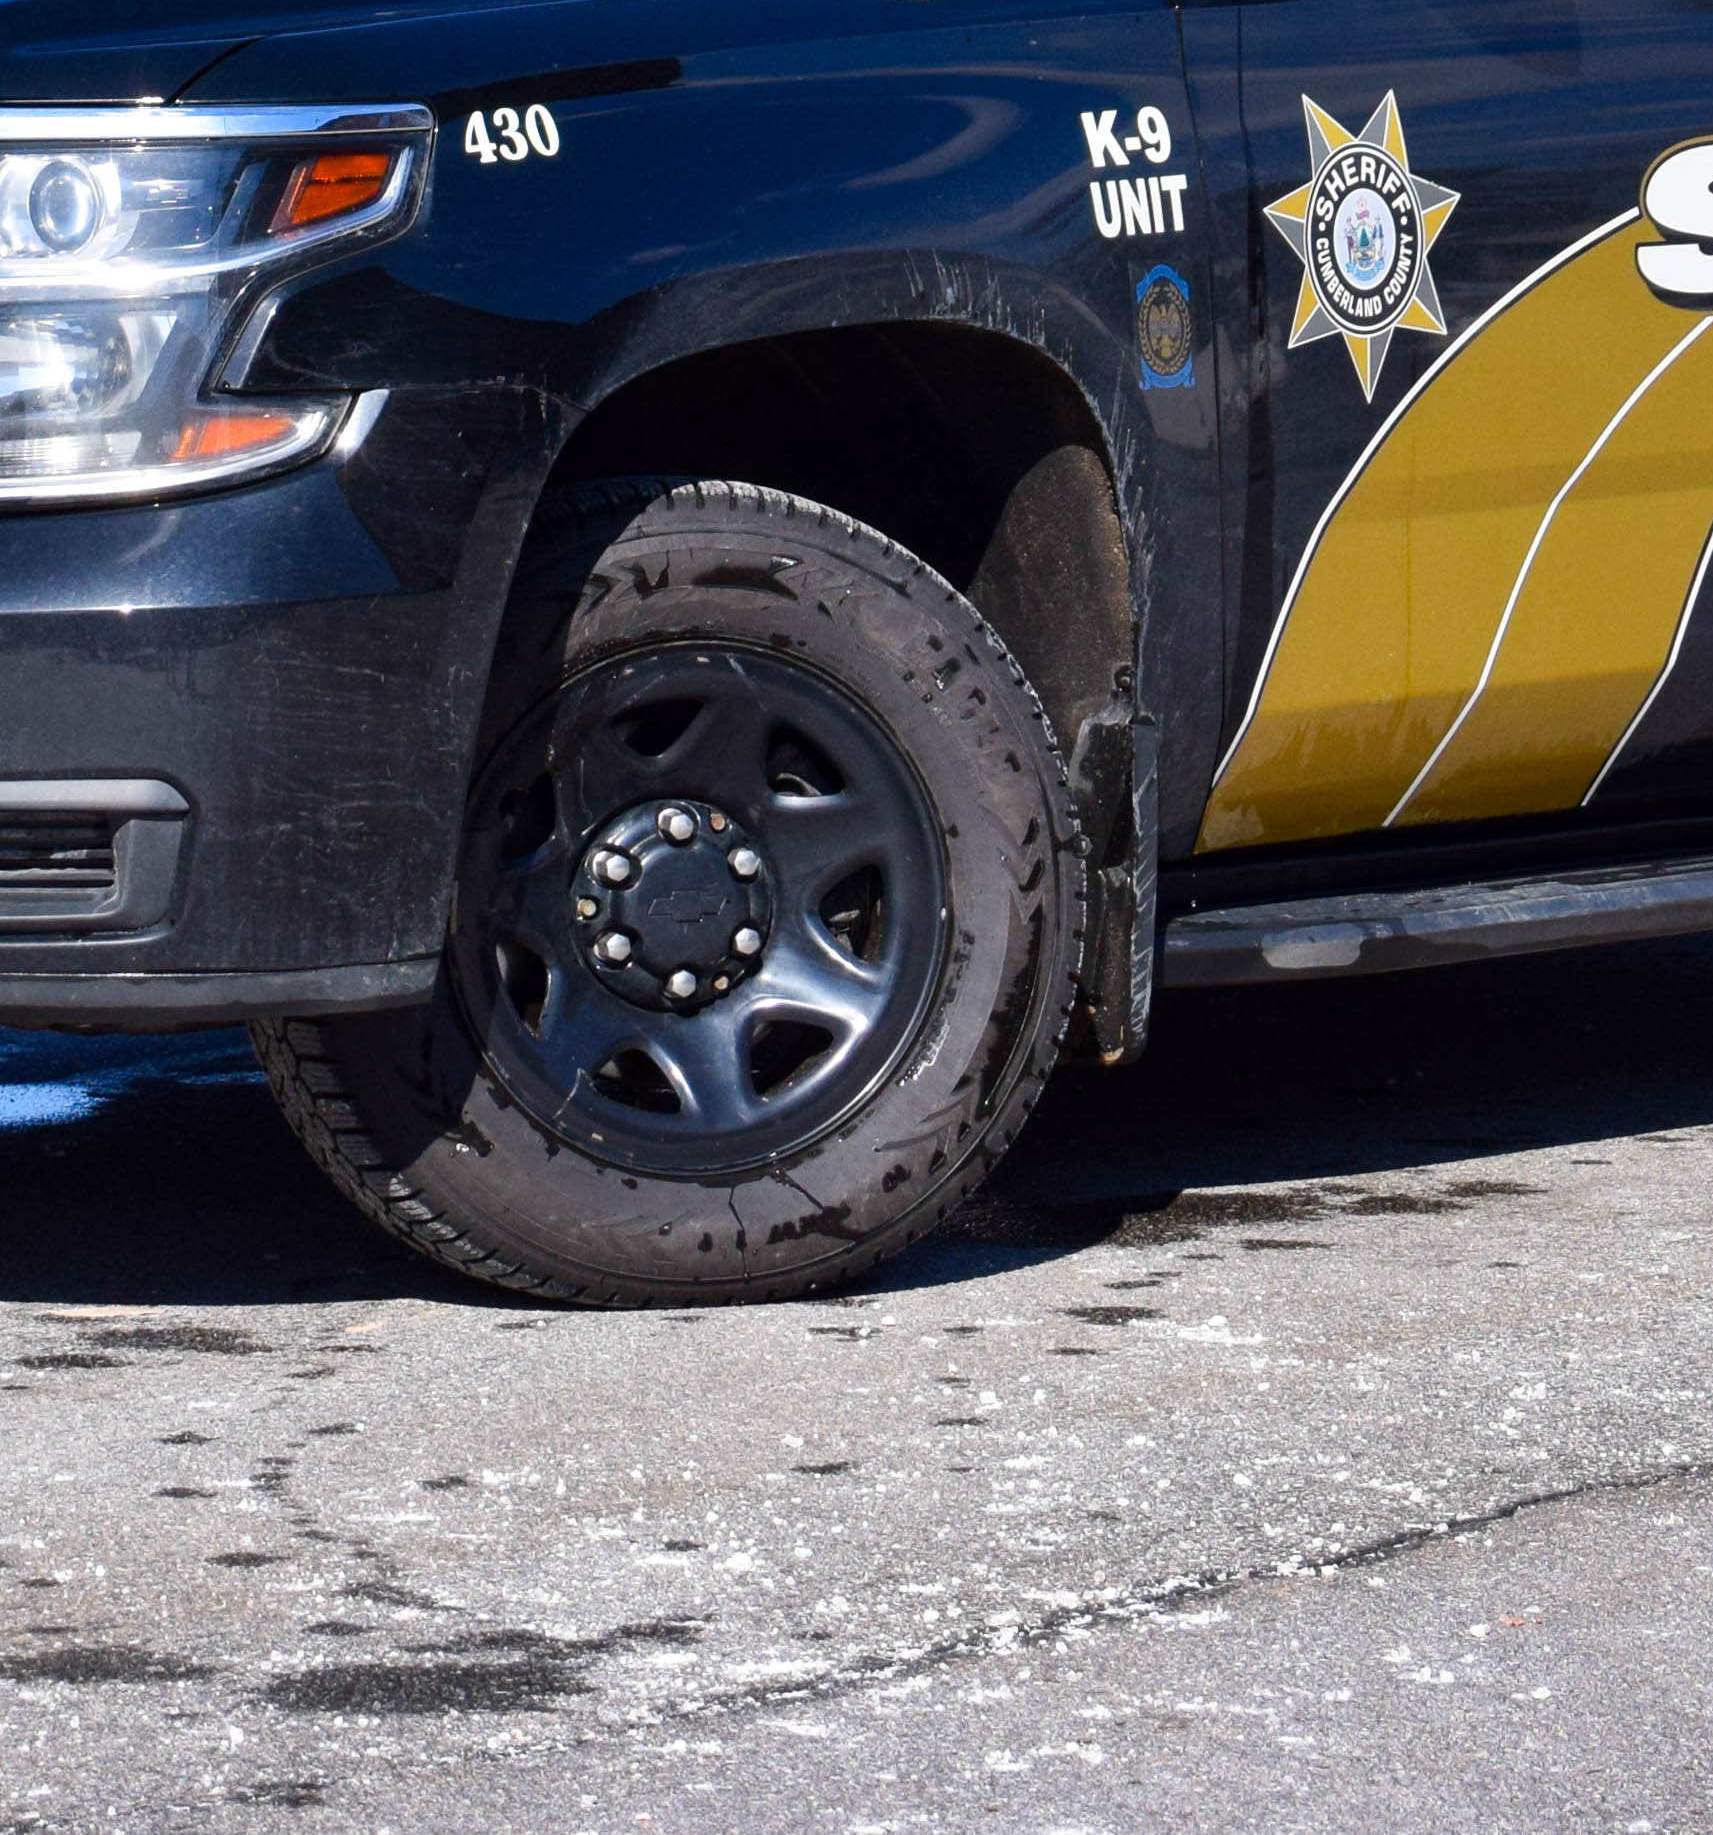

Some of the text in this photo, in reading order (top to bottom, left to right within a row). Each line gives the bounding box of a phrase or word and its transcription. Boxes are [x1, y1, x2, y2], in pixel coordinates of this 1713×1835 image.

[464, 103, 561, 164] 430
[1080, 105, 1171, 168] K-9
[1089, 173, 1188, 239] UNIT
[1315, 154, 1413, 224] SHERIFF
[1315, 233, 1414, 318] CUMBERLAND COUNTY
